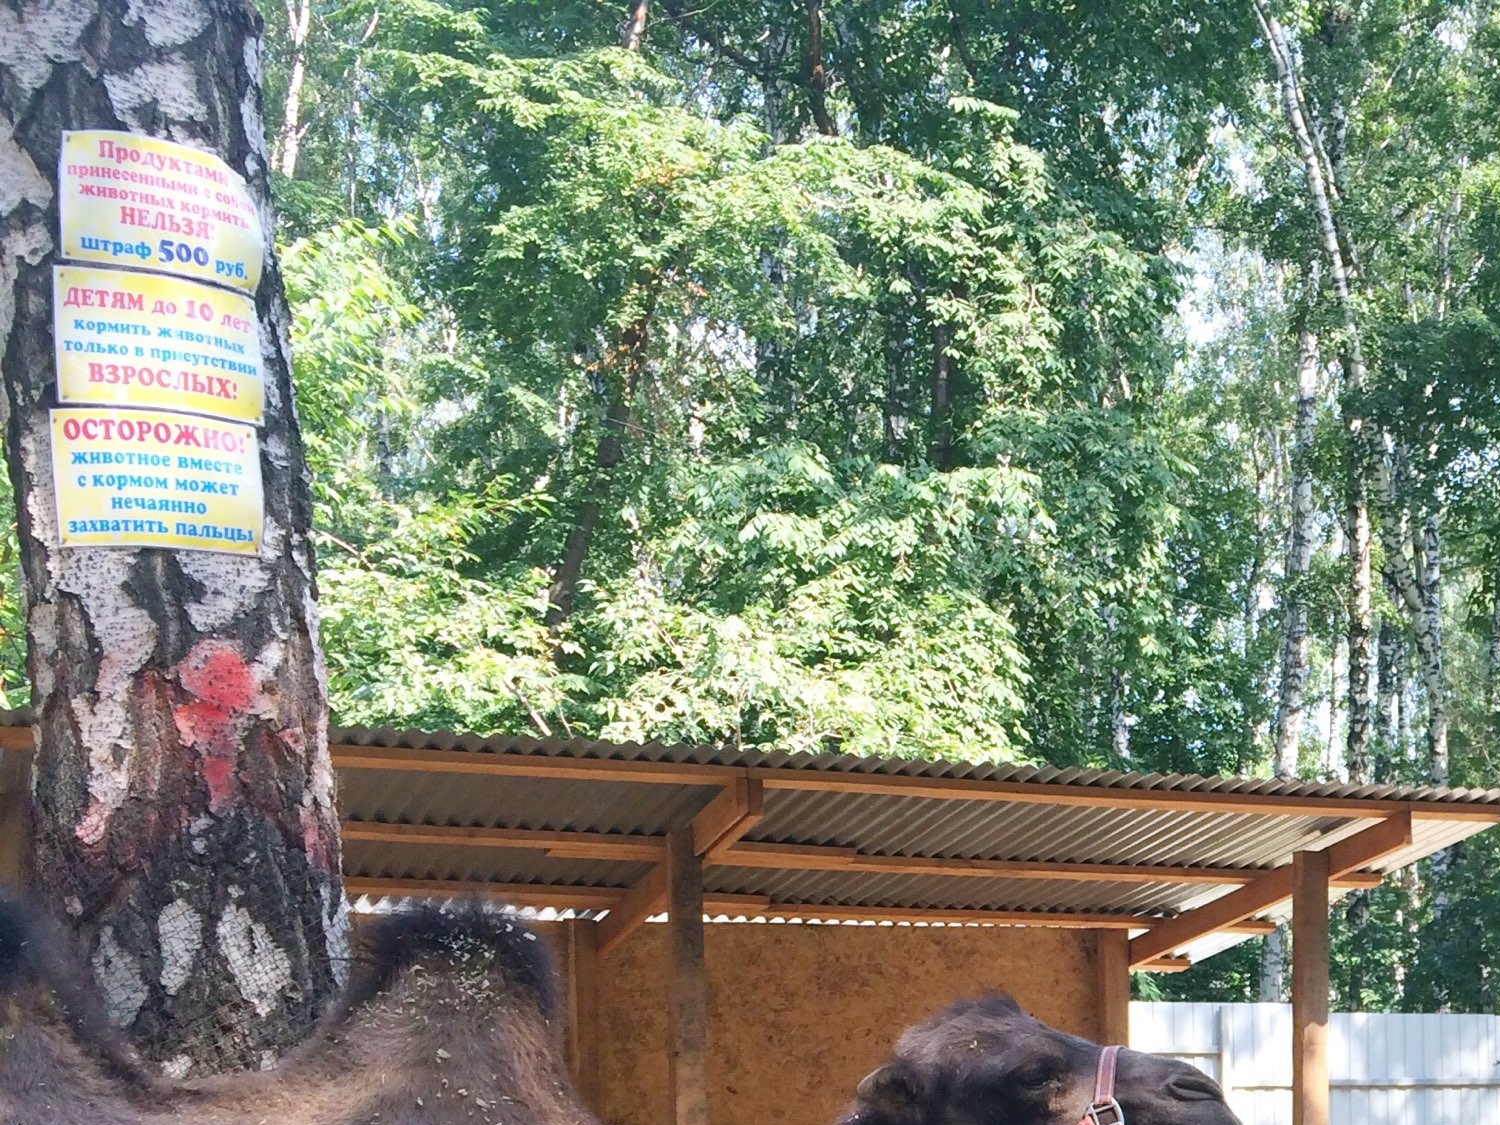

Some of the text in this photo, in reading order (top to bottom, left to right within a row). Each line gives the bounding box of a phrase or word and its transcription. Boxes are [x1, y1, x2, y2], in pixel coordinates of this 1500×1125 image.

[98, 139, 228, 186] Продуктами
[67, 164, 198, 196] принесенными
[203, 186, 211, 199] с
[79, 183, 250, 230] животных кормить
[80, 236, 248, 280] штраф 500 руб.
[63, 287, 251, 333] ДЕТЯМ до 10 лет
[73, 319, 245, 354] кормить животных
[64, 339, 257, 376] только в присутствии
[88, 362, 238, 400] ВЗРОСЛЫХ!
[63, 418, 245, 453] ОСТОРОЖНО!
[71, 451, 243, 474] животное вместе
[77, 474, 239, 496] с кормом может
[111, 496, 207, 514] нечаянно
[68, 519, 254, 543] захватить пальцы
